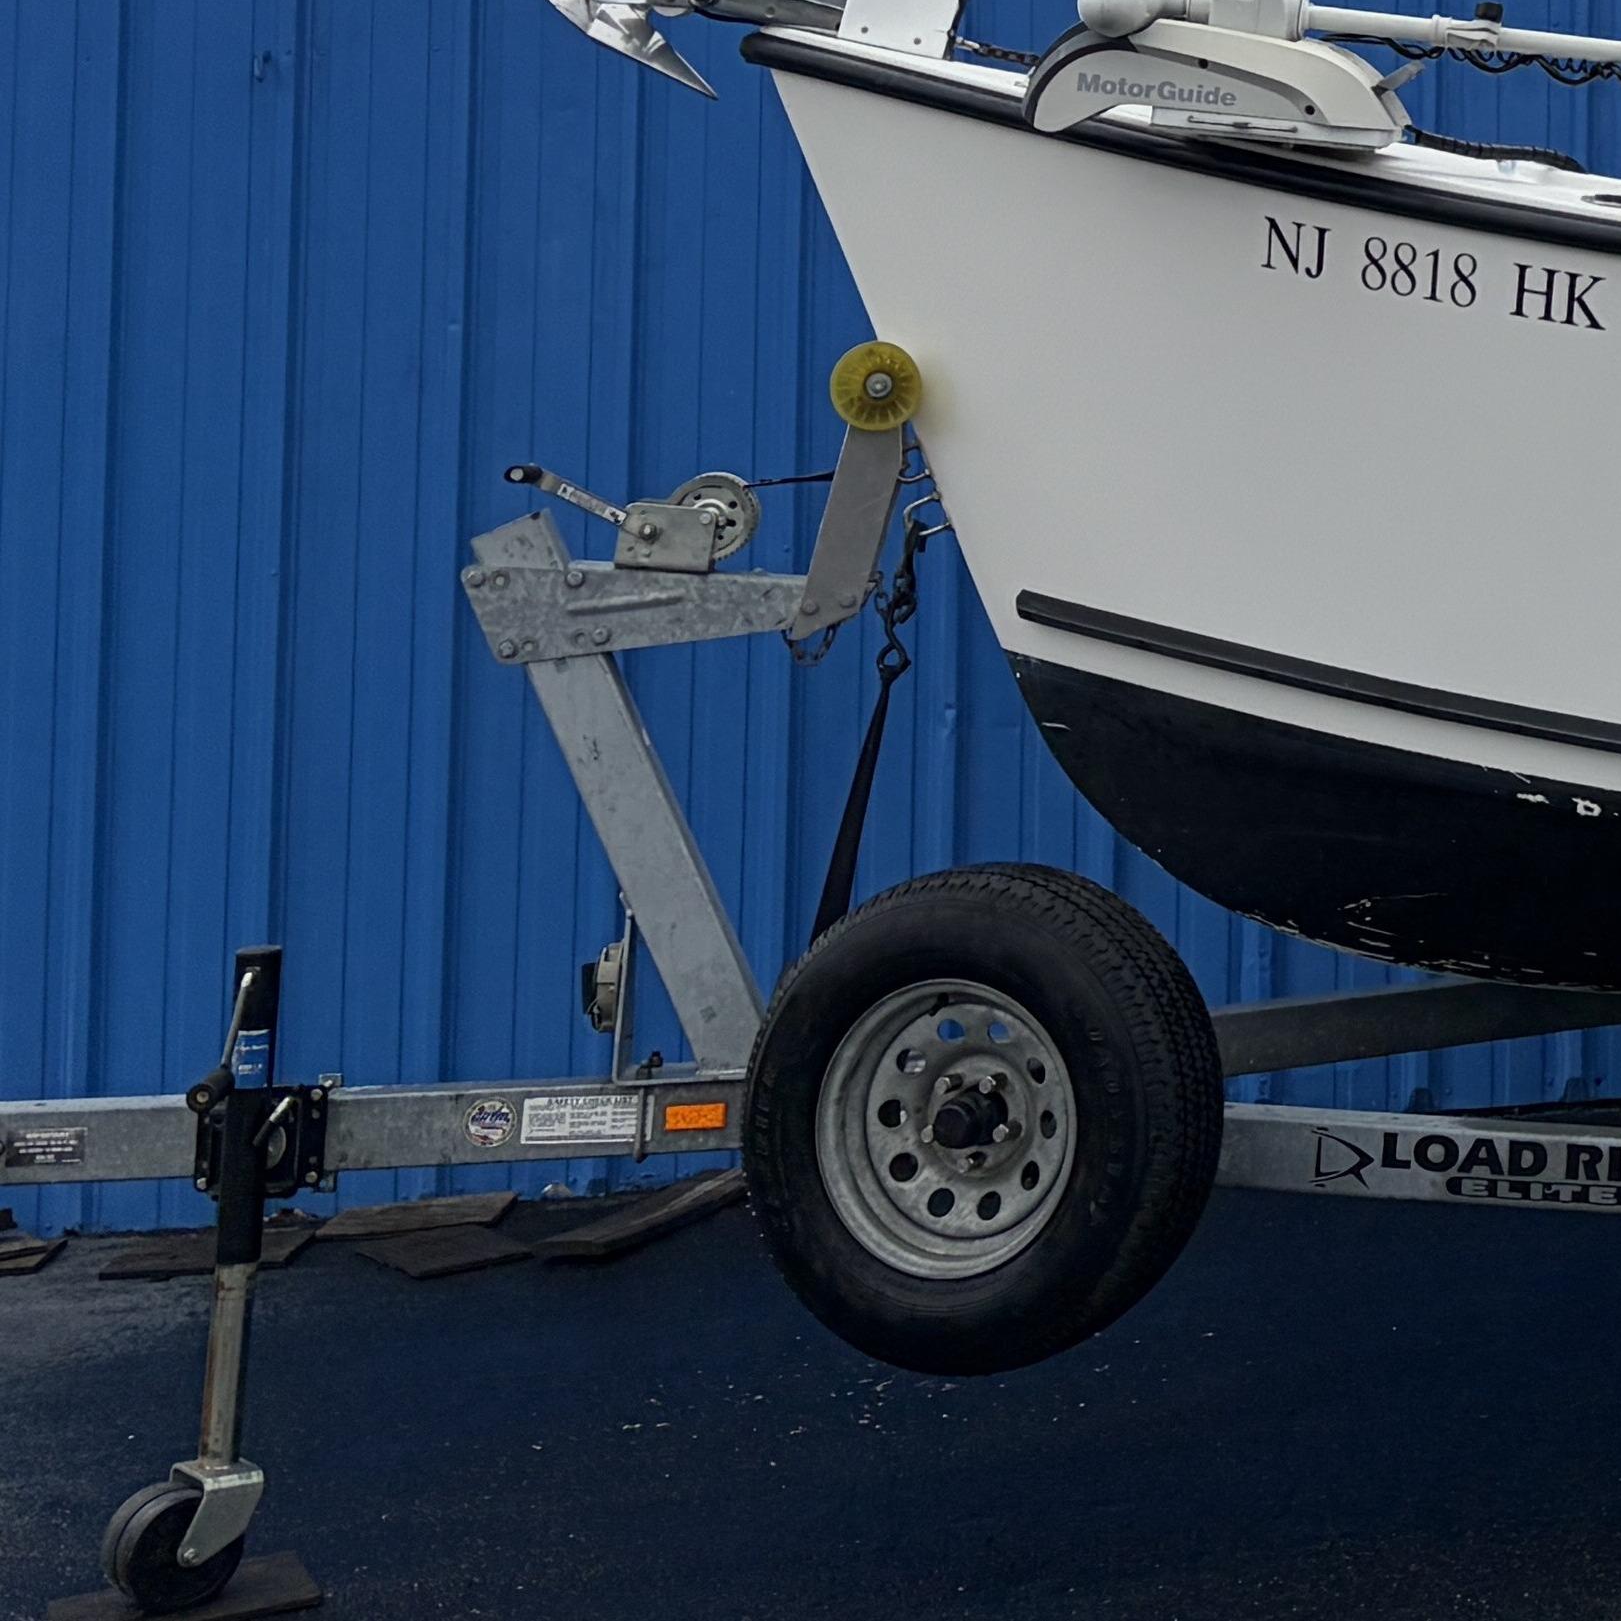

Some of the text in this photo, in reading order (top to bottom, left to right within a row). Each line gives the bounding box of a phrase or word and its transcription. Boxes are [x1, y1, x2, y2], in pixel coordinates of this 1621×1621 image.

[1076, 72, 1237, 107] MotorGuide
[1260, 215, 1607, 331] NJ 8818 HK
[1381, 1132, 1548, 1177] LOAD
[1461, 1179, 1619, 1205] ELITE
